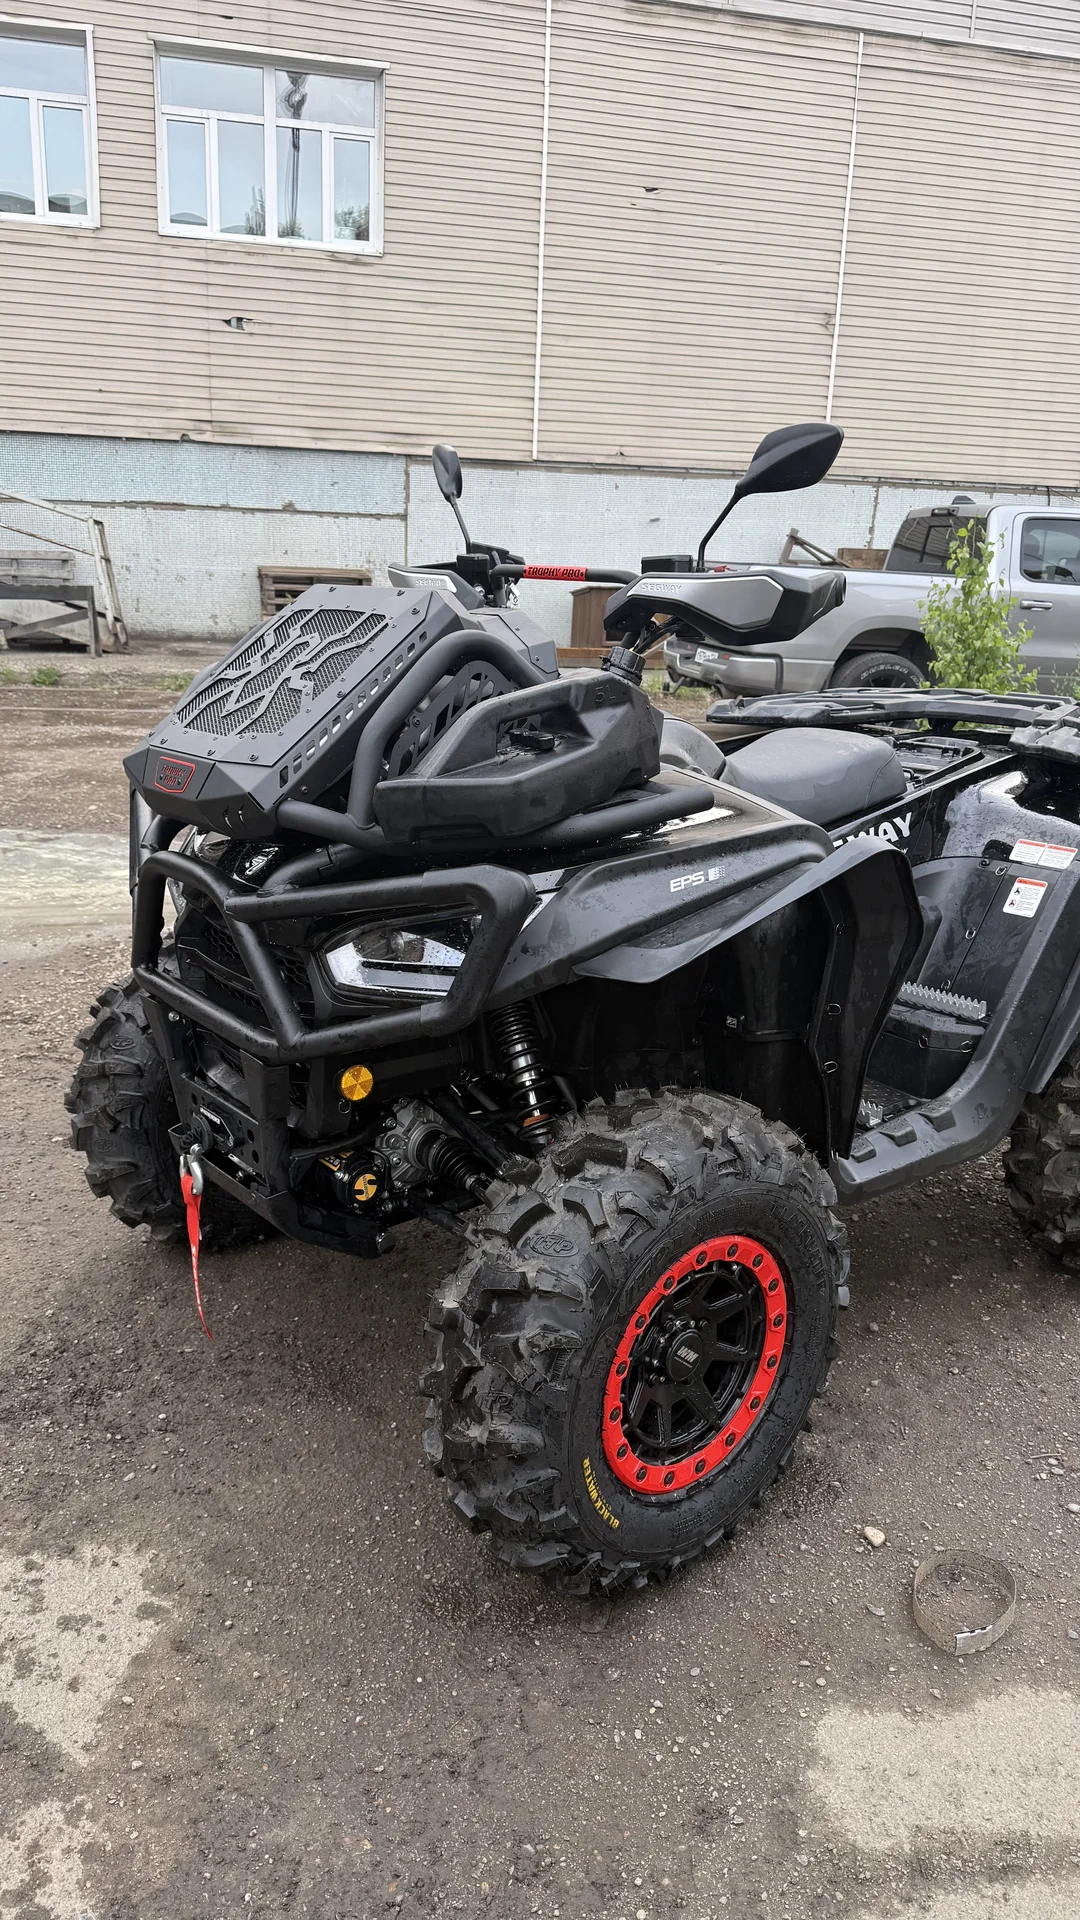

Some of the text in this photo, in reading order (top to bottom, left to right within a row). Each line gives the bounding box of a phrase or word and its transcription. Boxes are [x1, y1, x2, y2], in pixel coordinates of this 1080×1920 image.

[527, 566, 581, 578] TROPHY PRO
[641, 582, 682, 594] SEGWAY
[670, 870, 705, 893] EPS
[532, 1236, 574, 1254] ITP
[582, 1456, 620, 1530] BLACKWATER
